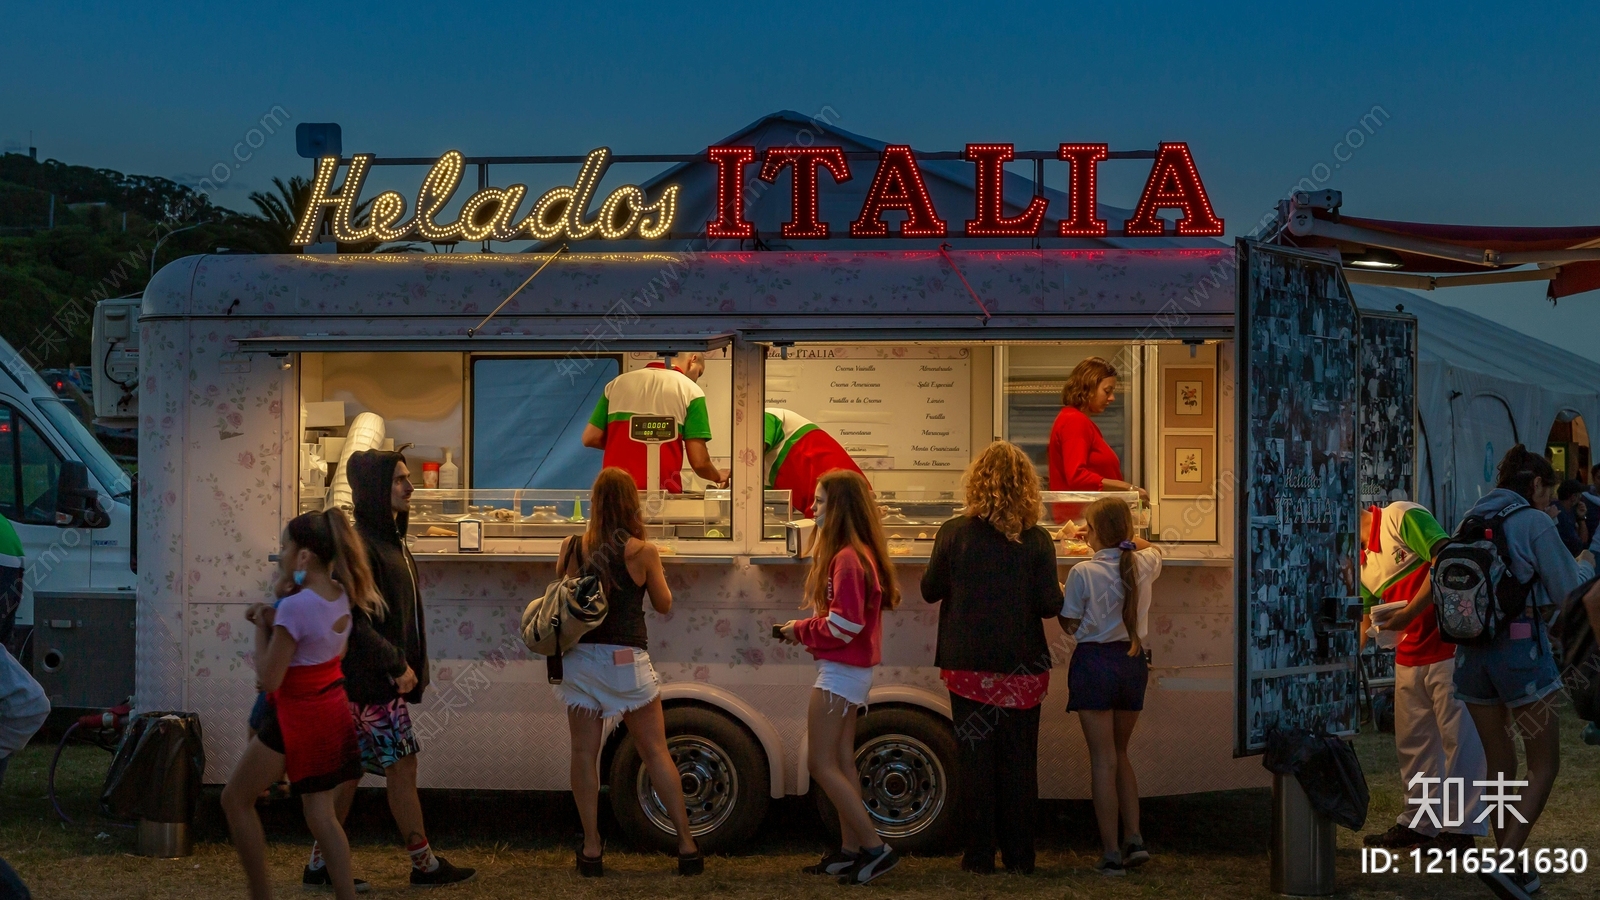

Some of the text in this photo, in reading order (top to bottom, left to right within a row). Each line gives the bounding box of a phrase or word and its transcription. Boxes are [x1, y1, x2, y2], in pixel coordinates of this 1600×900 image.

[291, 142, 1225, 246] Helados ITALIA
[796, 349, 835, 358] ITALIA
[849, 380, 881, 388] Americana
[917, 381, 954, 389] Split Especial
[930, 444, 960, 452] Granizada
[1284, 466, 1323, 490] Helados
[1274, 497, 1334, 524] ITALIA
